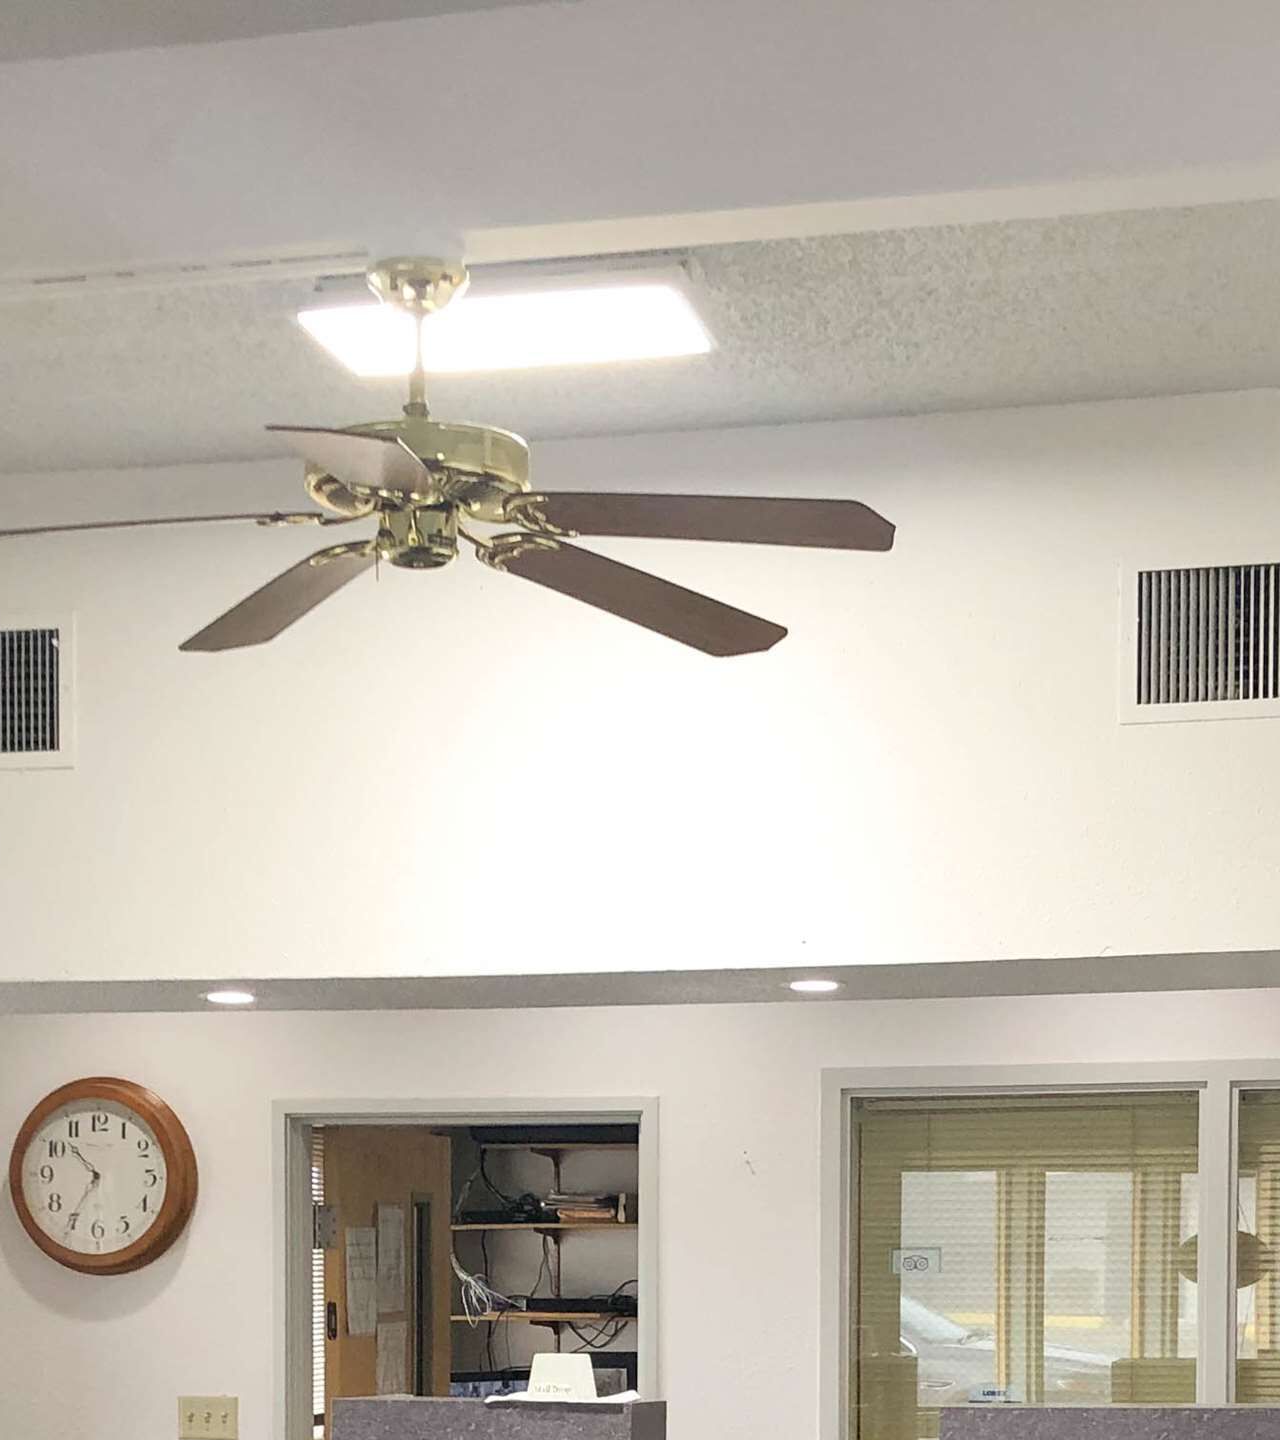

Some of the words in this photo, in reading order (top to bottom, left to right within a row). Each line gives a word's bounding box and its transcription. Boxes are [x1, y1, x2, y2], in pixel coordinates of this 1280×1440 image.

[68, 1120, 79, 1138] 11
[91, 1113, 109, 1132] 12
[121, 1122, 126, 1139] 1
[48, 1140, 65, 1158] 10
[137, 1139, 149, 1158] 2
[40, 1164, 54, 1184] 9
[48, 1193, 62, 1212] 8
[91, 1220, 105, 1239] 6
[115, 1216, 130, 1234] 5
